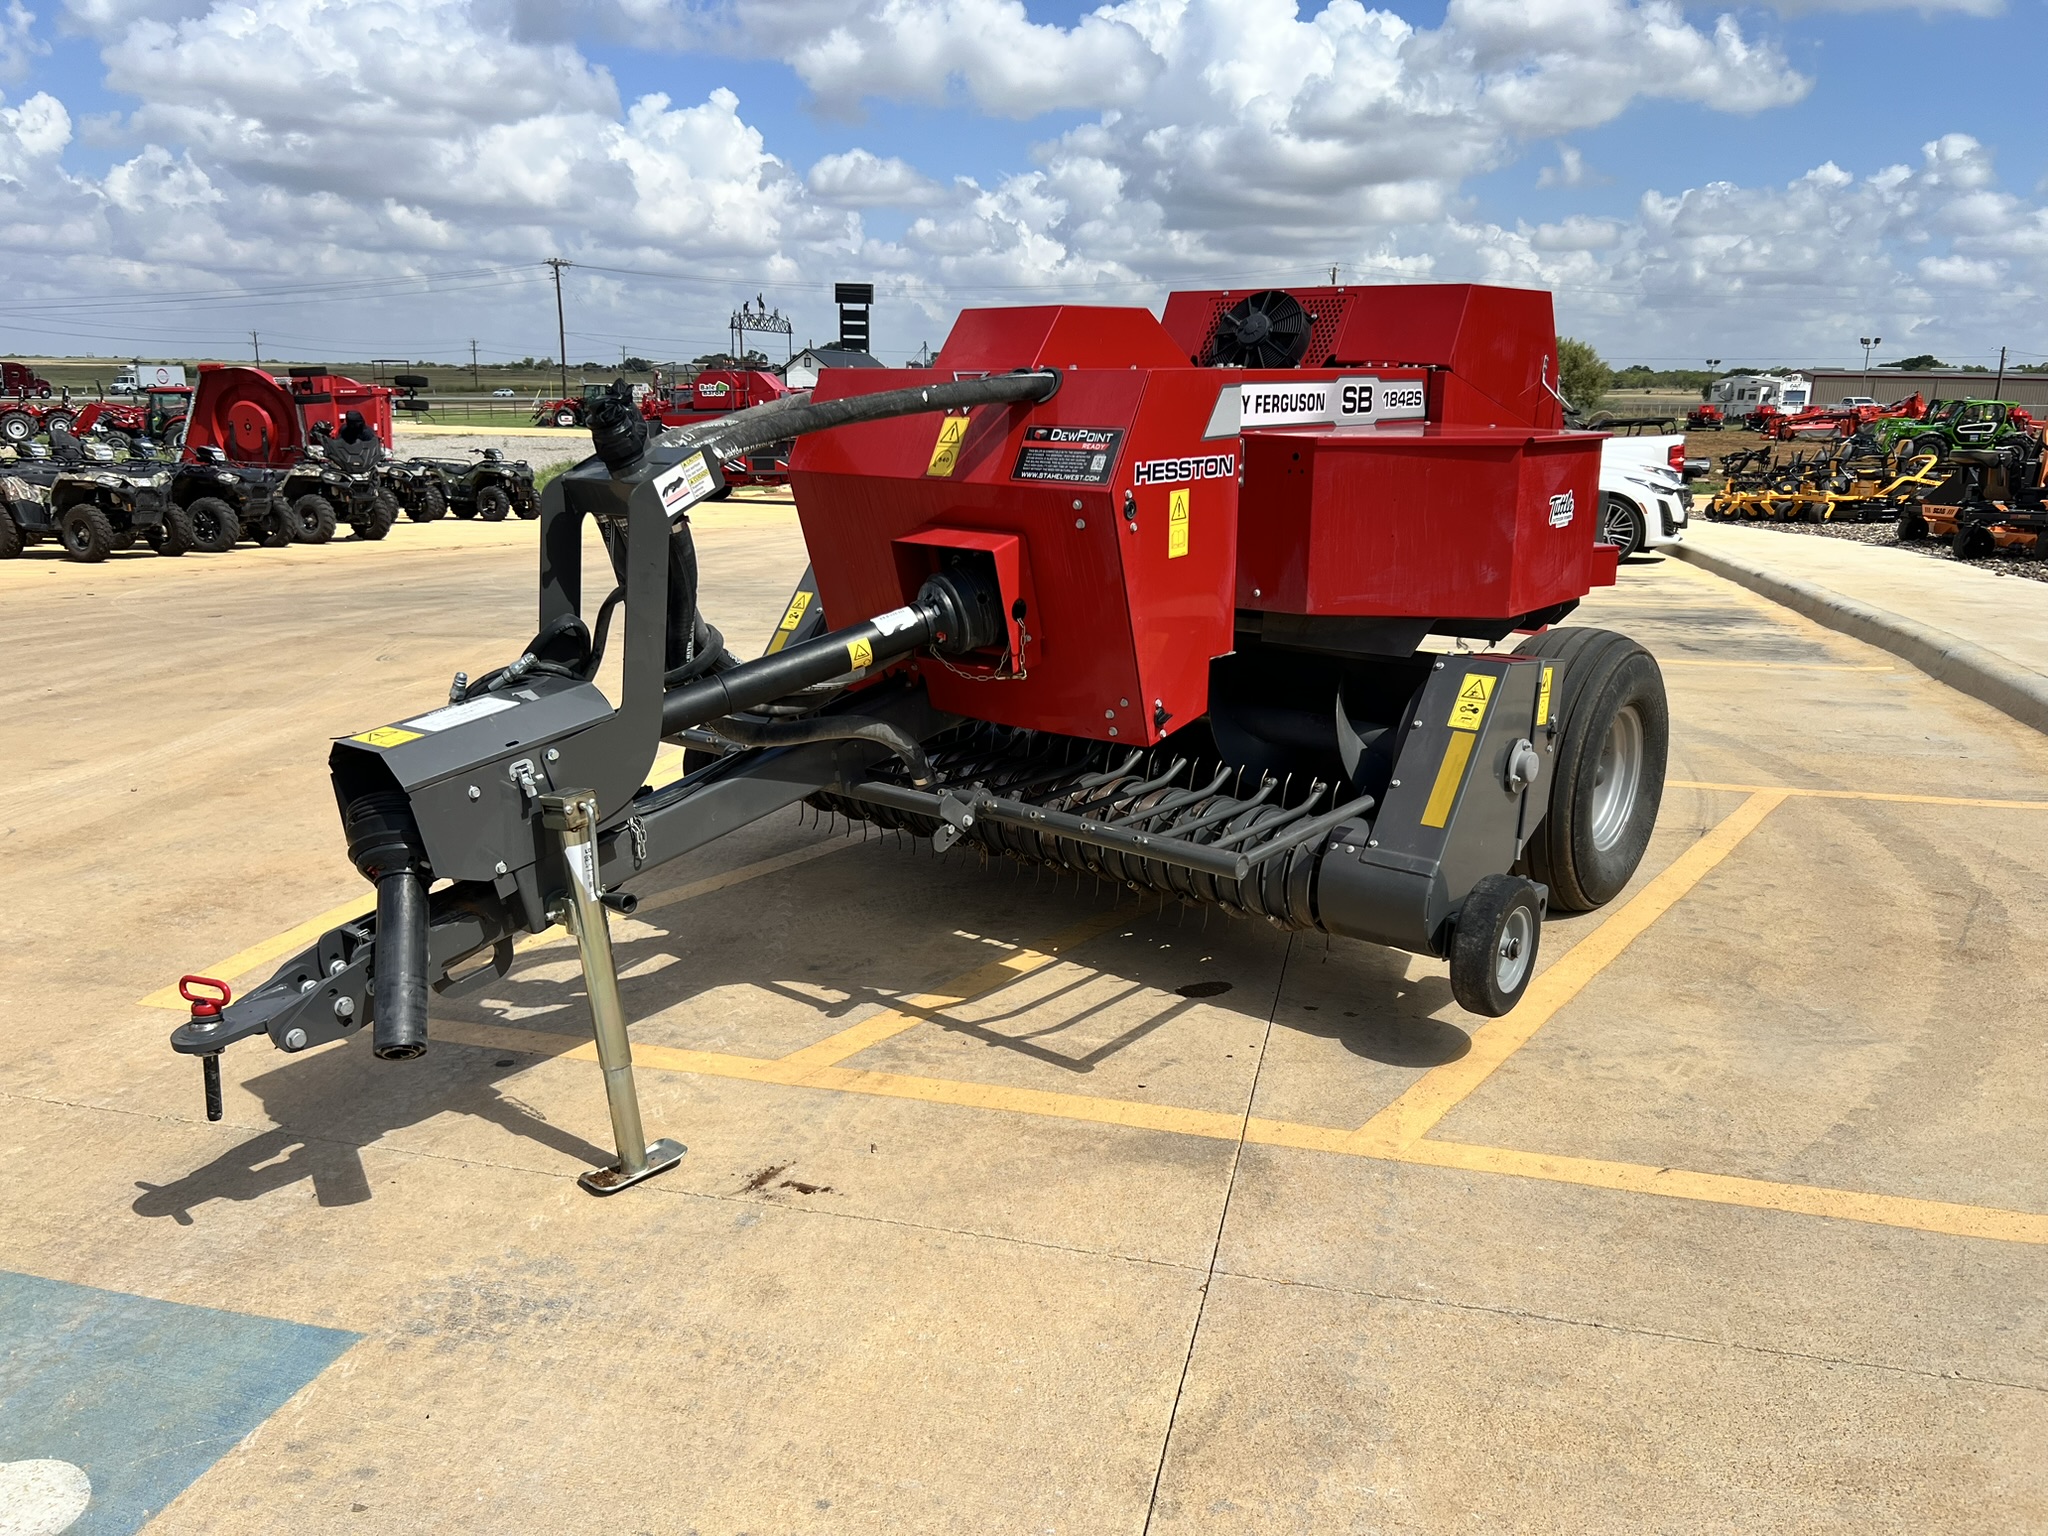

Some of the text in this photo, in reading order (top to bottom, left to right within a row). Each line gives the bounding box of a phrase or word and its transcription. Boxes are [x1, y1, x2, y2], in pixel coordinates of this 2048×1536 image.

[1255, 392, 1326, 414] FERGUSON
[1341, 385, 1373, 414] SB
[1382, 390, 1422, 408] 1842S
[1050, 428, 1114, 443] DEWPOINT
[1134, 454, 1235, 485] HESSTON
[1550, 491, 1573, 523] Tuttle
